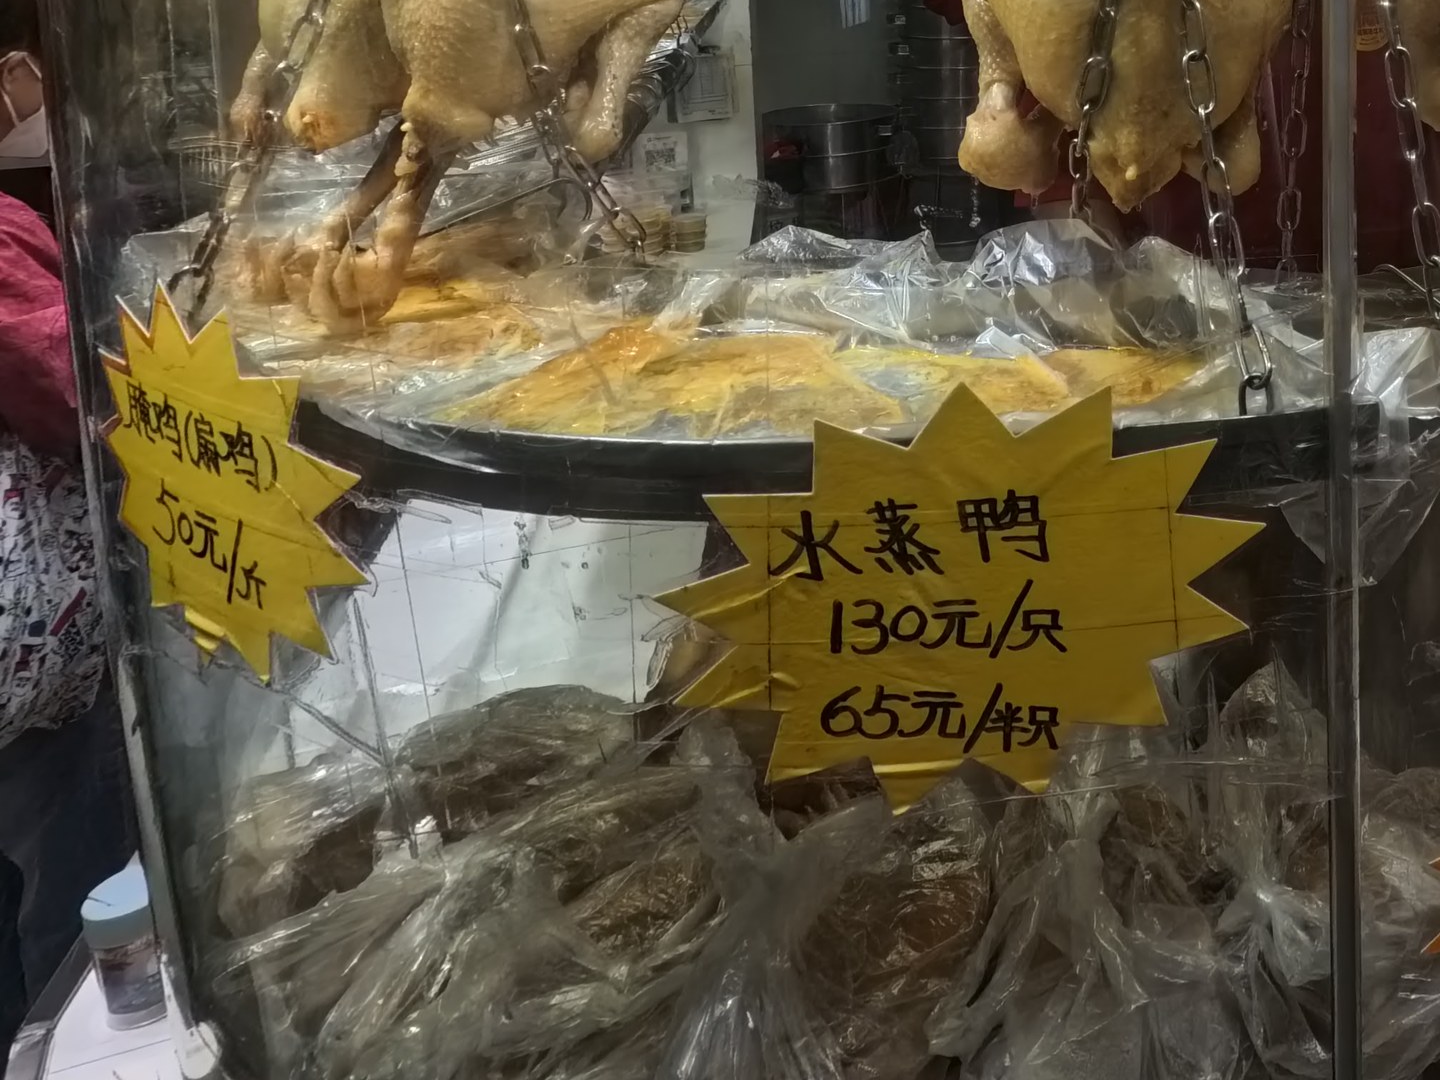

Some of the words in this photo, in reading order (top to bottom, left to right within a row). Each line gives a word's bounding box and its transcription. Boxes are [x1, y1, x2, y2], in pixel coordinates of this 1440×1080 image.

[152, 478, 267, 610] 50元/斤
[769, 489, 1051, 581] 水蒸鸭
[830, 579, 1068, 659] 130元/只
[820, 683, 1060, 754] 65元/半只
